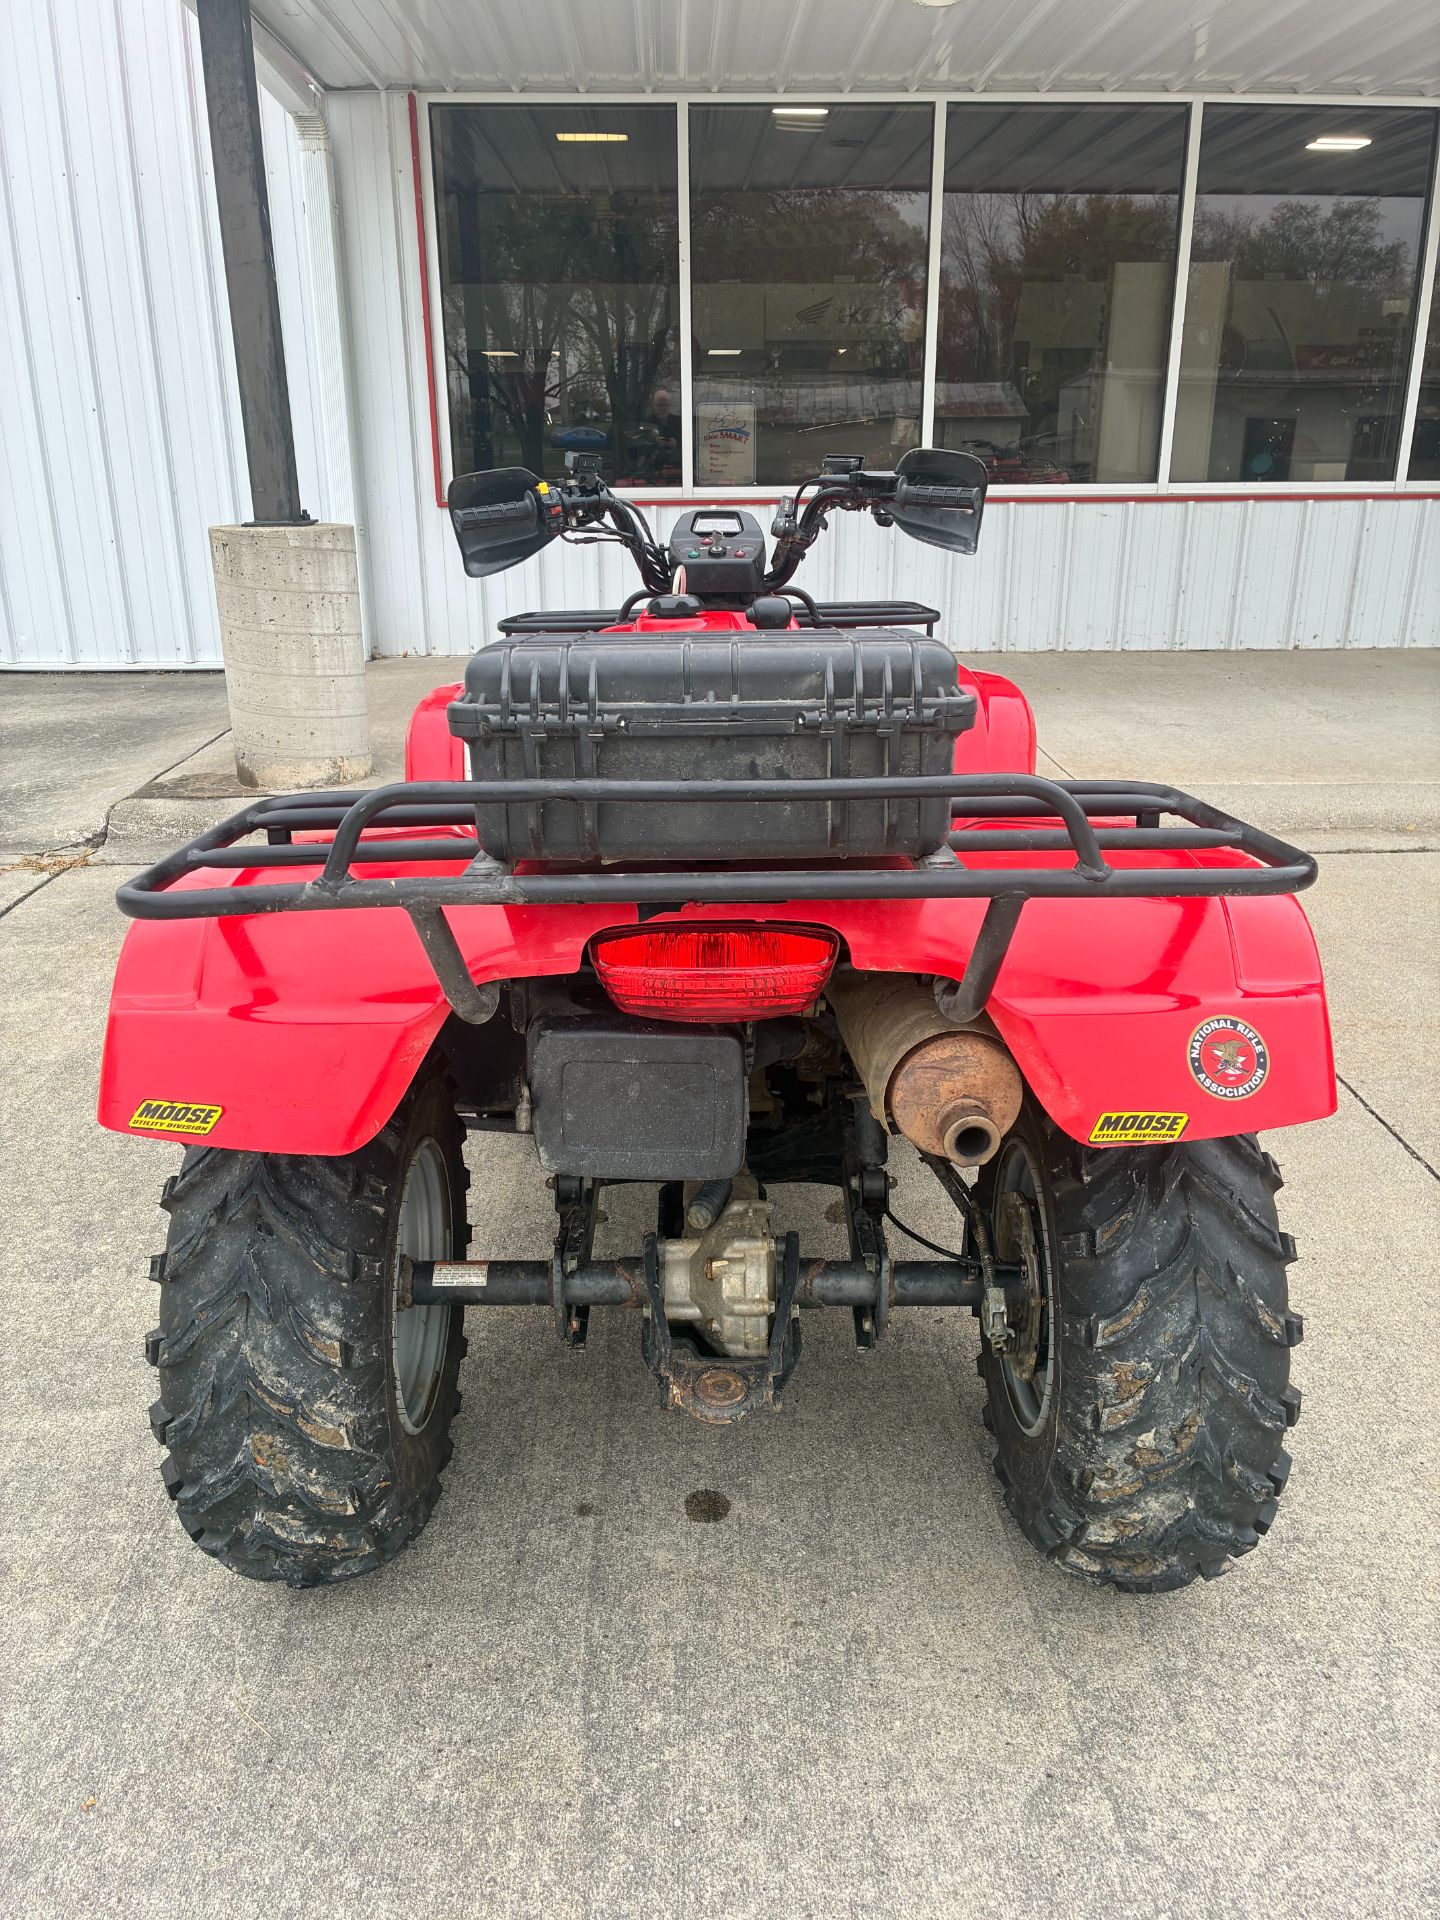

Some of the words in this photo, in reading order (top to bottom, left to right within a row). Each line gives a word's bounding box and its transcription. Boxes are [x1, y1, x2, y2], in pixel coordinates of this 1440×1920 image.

[719, 431, 750, 444] SMART
[1191, 1020, 1234, 1058] NATIONAL
[1236, 1023, 1264, 1054] RIFLE
[1197, 1068, 1265, 1097] ASSOCIATION
[137, 1103, 219, 1124] MOOSE
[132, 1119, 165, 1127] UTILITY
[166, 1123, 209, 1132] DIVISION
[1097, 1115, 1184, 1132] MOOSE
